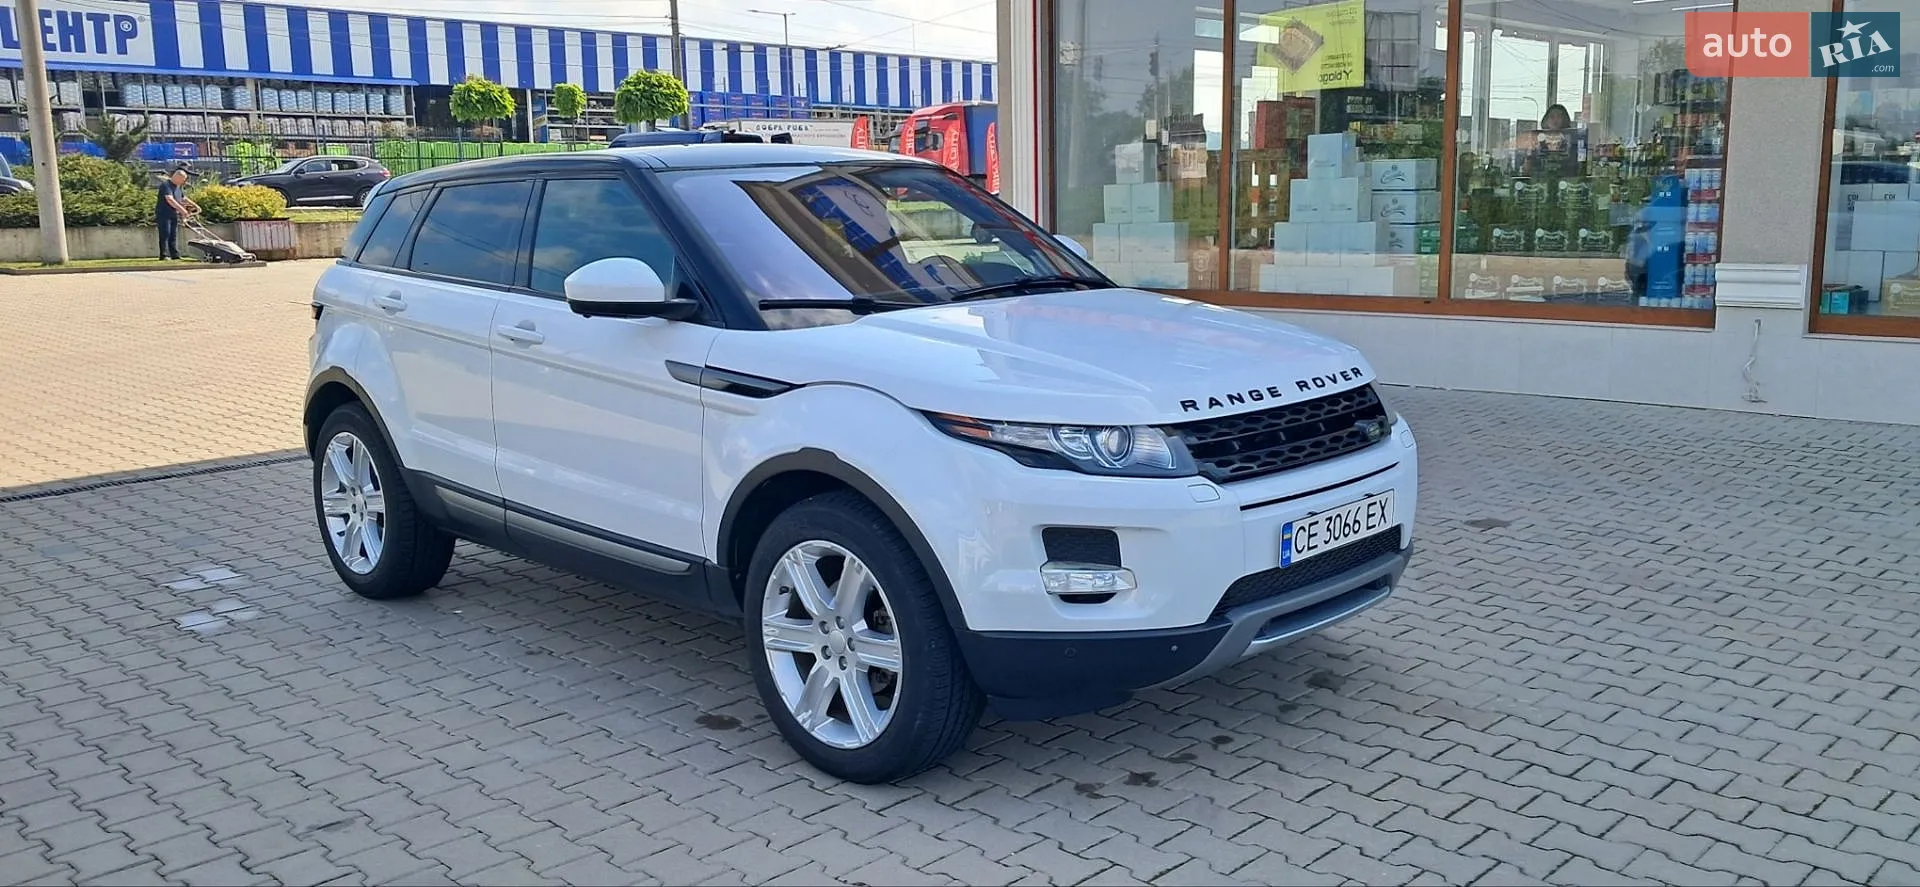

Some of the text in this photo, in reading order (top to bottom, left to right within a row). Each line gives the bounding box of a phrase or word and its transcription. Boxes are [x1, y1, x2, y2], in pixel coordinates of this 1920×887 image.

[1180, 367, 1363, 412] RANGE ROVER
[1294, 497, 1388, 554] CE 3066 EX
